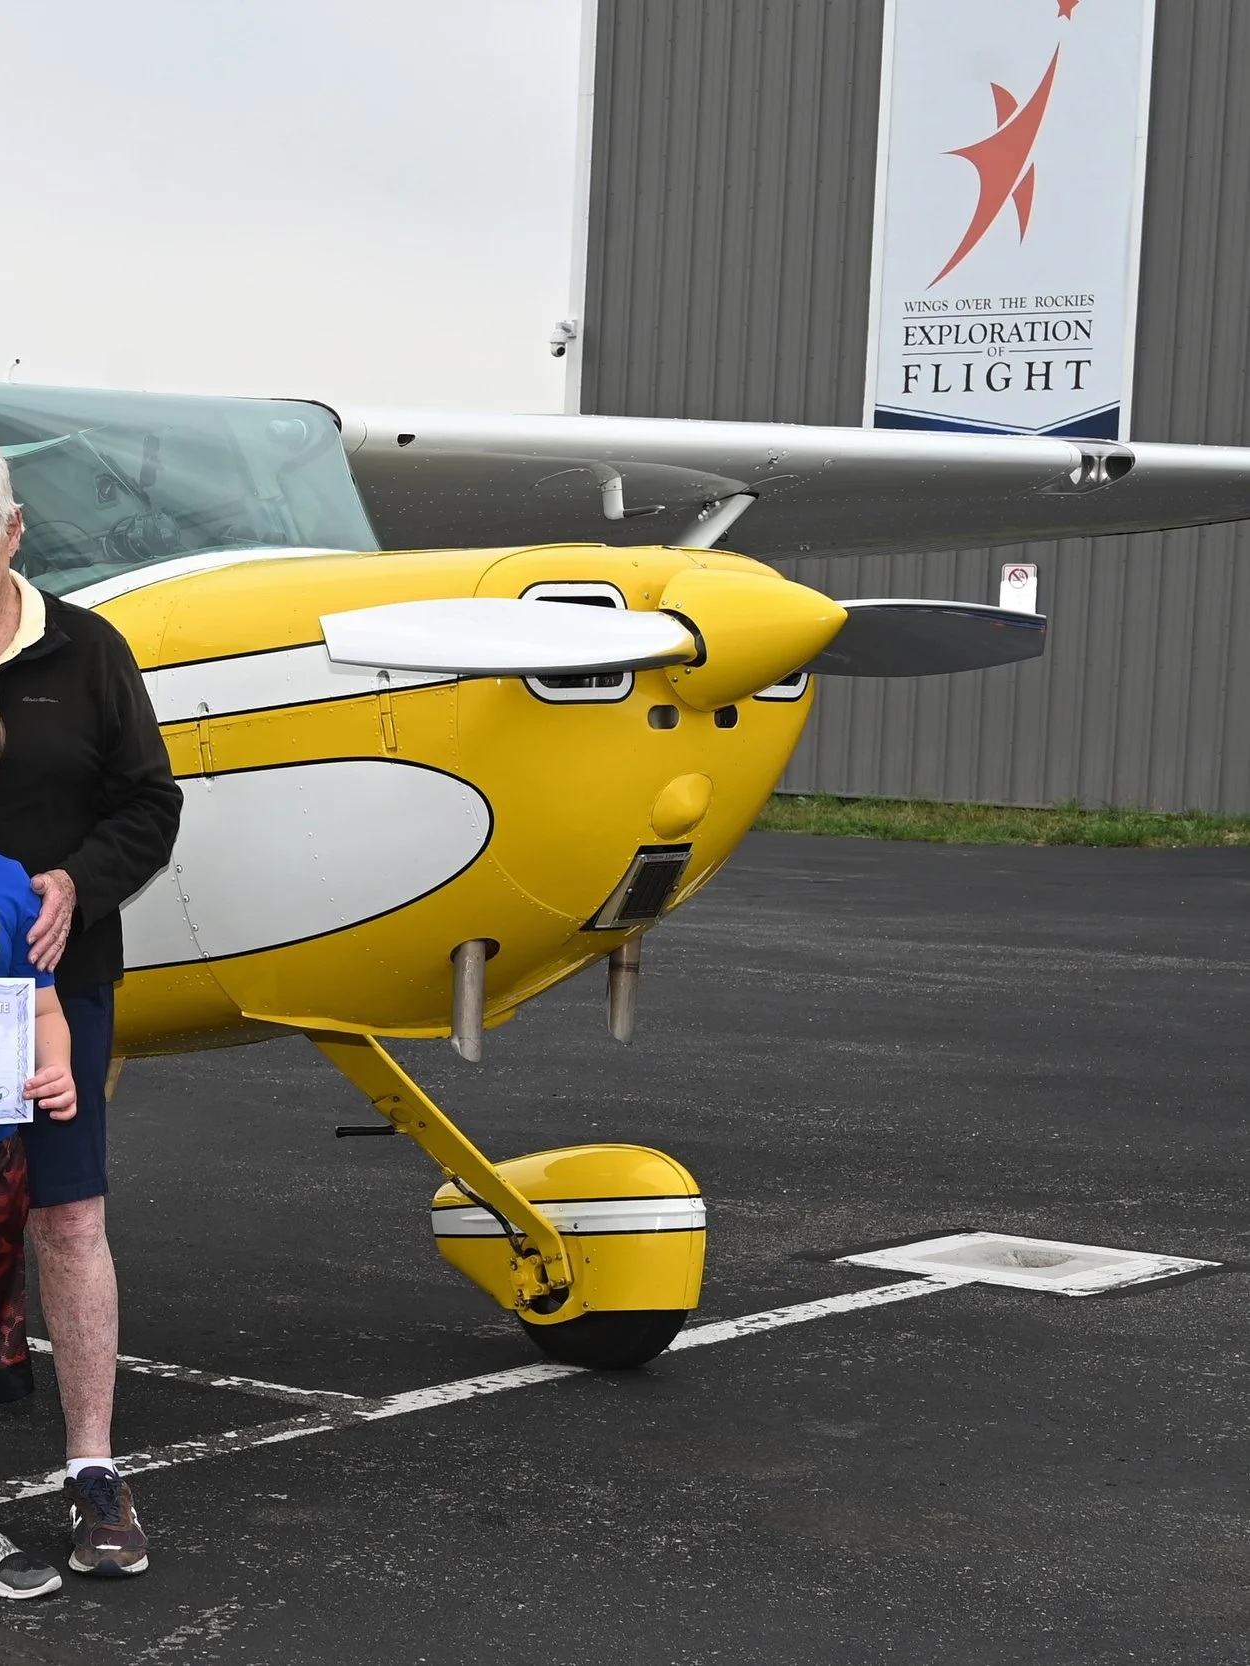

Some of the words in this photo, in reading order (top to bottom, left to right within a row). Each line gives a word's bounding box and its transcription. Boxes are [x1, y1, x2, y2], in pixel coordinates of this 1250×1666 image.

[904, 299, 949, 313] WINGS
[955, 298, 992, 311] OVER
[999, 296, 1027, 309] THE
[1035, 294, 1095, 308] ROCKIES
[902, 319, 1093, 346] EXPLORATION
[987, 346, 1005, 357] OF
[901, 360, 1092, 394] FLIGHT
